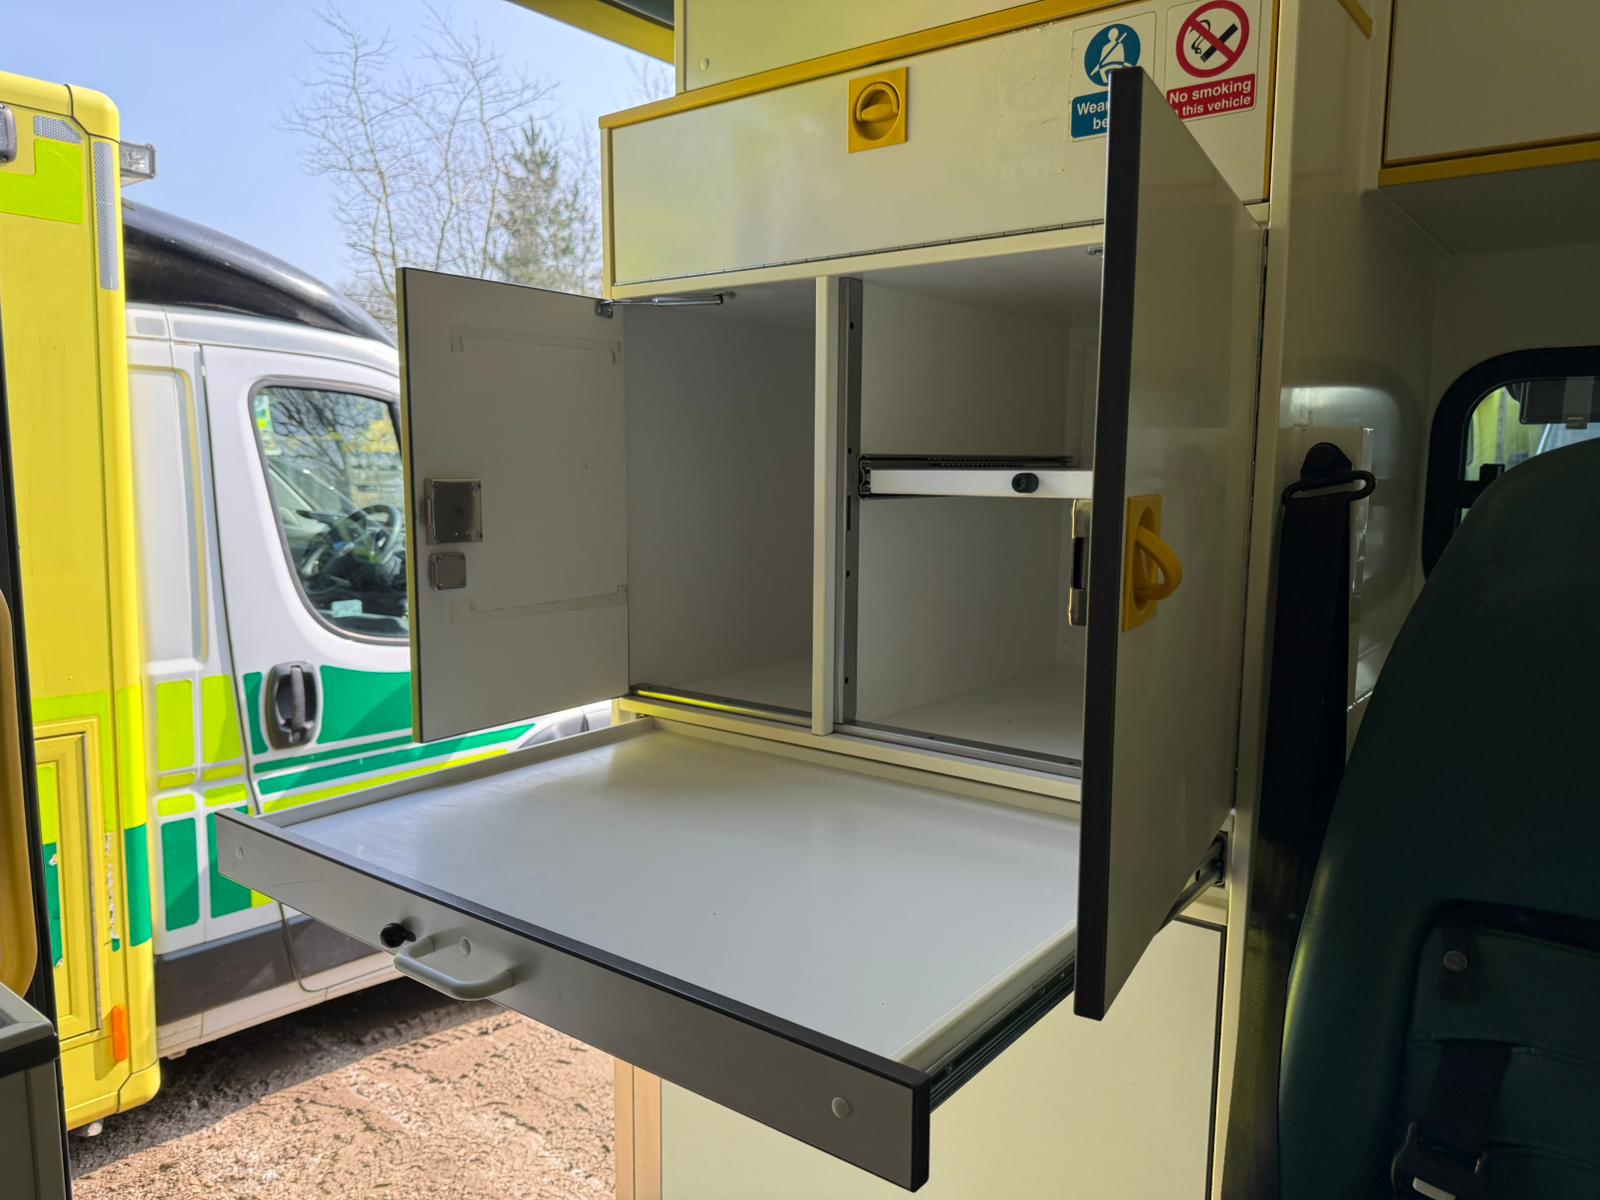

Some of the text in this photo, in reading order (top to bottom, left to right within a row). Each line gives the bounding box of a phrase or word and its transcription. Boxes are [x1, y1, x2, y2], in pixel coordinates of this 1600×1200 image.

[1169, 80, 1252, 105] No smoking
[1182, 103, 1204, 116] this
[1207, 95, 1251, 112] vehicle
